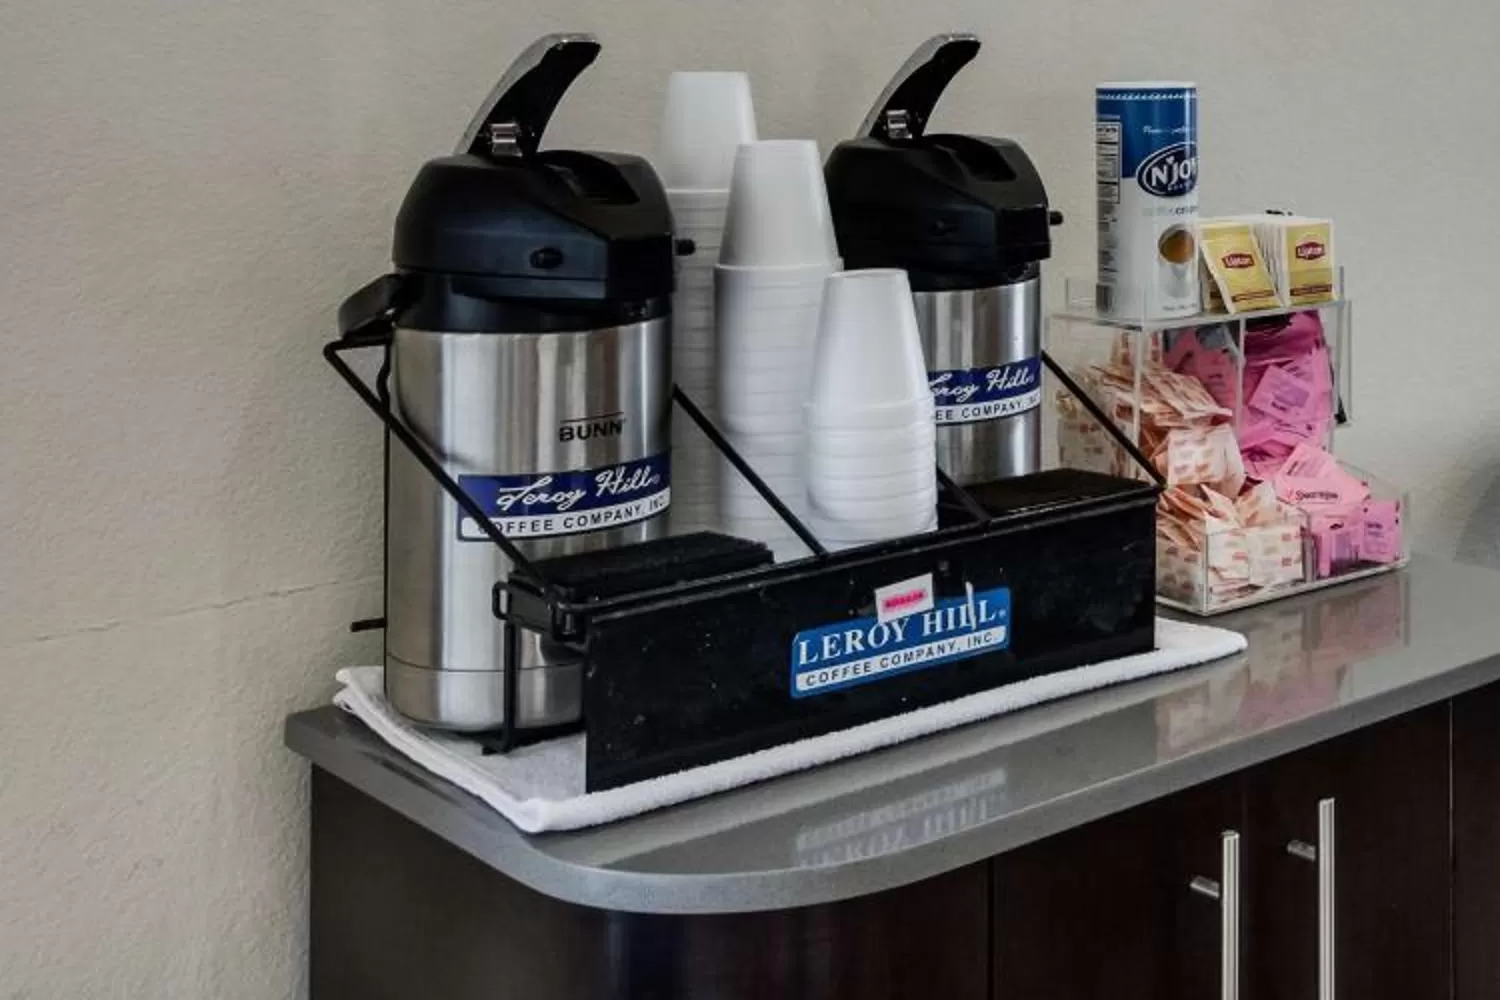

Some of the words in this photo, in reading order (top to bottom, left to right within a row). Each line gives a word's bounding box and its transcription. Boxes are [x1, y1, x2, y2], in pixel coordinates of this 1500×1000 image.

[560, 419, 623, 442] BUNN
[496, 475, 586, 511] Leroy
[595, 466, 651, 497] Hill
[799, 617, 909, 665] LEROY
[806, 660, 872, 686] COFFEE
